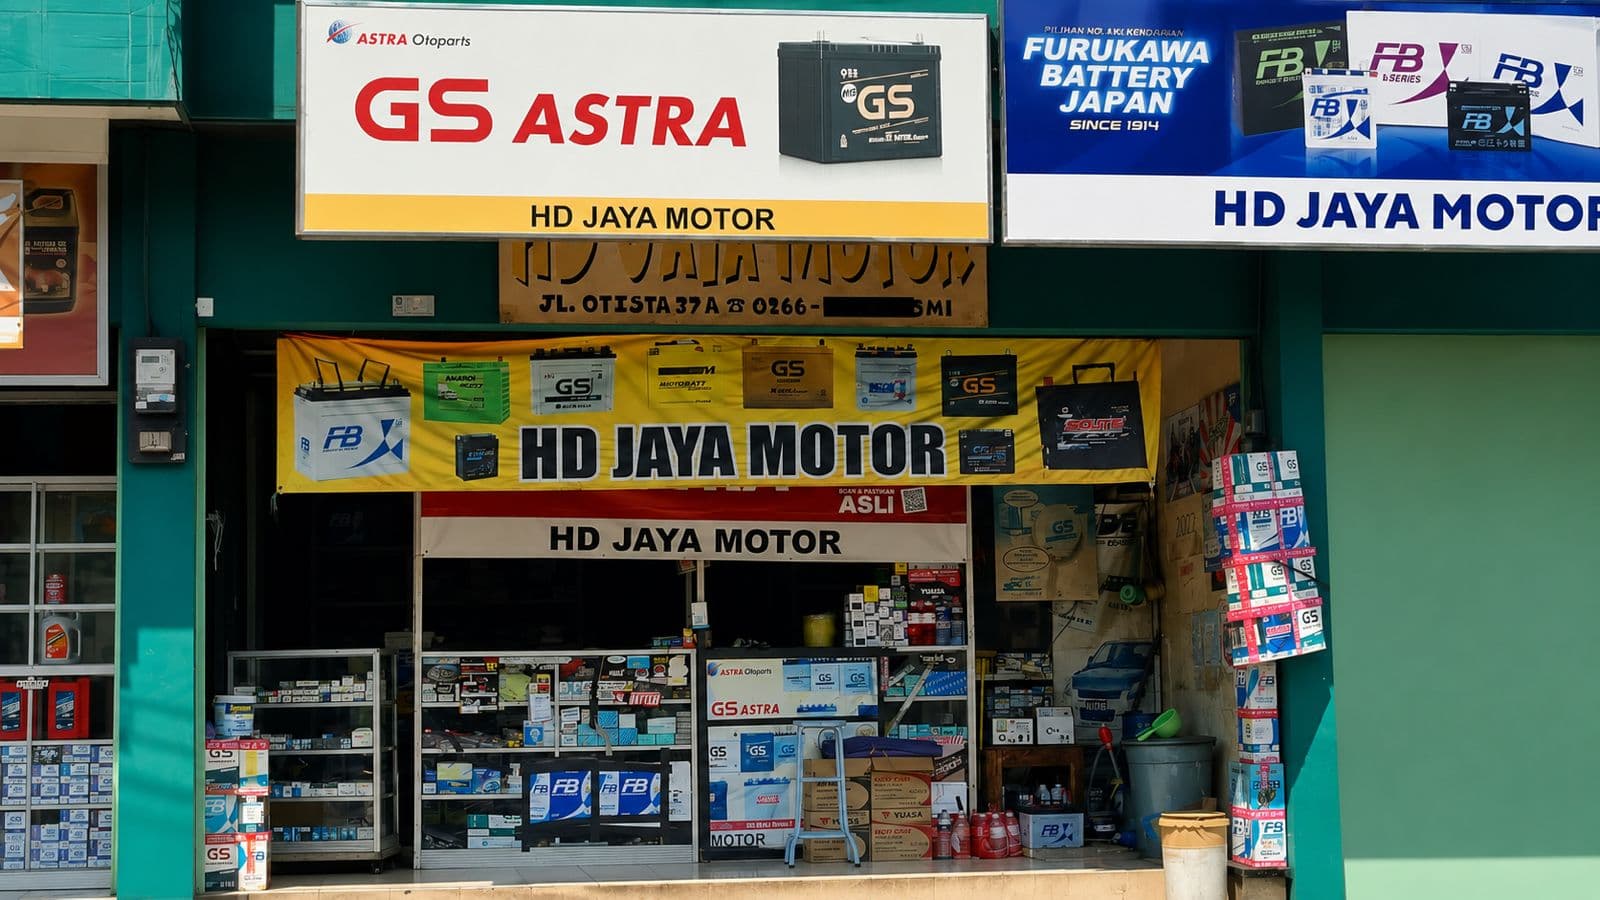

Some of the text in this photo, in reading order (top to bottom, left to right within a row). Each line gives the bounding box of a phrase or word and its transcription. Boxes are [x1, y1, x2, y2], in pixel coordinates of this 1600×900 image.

[357, 32, 471, 49] ASTRA Otoparts
[1023, 37, 1210, 64] FURUKAWA
[1369, 42, 1425, 73] FB
[1255, 47, 1305, 80] FB
[1493, 53, 1545, 88] FB
[1040, 64, 1195, 89] BATTERY
[856, 84, 915, 120] GS
[1059, 90, 1173, 114] JAPAN
[1310, 98, 1341, 117] FB
[355, 77, 747, 148] GS ASTRA
[1462, 112, 1493, 130] FB
[1069, 120, 1159, 131] SINCE 1914
[530, 205, 775, 231] HD JAYA MOTOR
[1214, 190, 1286, 227] HD
[1296, 192, 1419, 229] JAYA
[539, 294, 576, 313] JL.
[582, 295, 671, 314] OTISTA
[771, 360, 805, 377] GS
[555, 377, 591, 395] GS
[962, 377, 996, 394] GS
[322, 425, 364, 450] FB
[519, 423, 948, 482] HD JAYA MOTOR
[1256, 461, 1268, 472] GS
[1286, 459, 1297, 470] GS
[838, 495, 894, 514] ASLI
[1052, 520, 1075, 534] GS
[549, 525, 842, 555] HD JAYA MOTOR
[1300, 559, 1312, 571] GS
[1302, 609, 1319, 624] GS
[720, 668, 772, 677] ASTRA Otoparts
[818, 673, 832, 682] GS
[850, 673, 865, 683] GS
[711, 701, 780, 716] GS ASTRA
[710, 746, 727, 757] GS
[750, 745, 767, 756] GS
[781, 744, 795, 754] GS
[552, 778, 579, 794] FB
[621, 778, 648, 793] FB
[894, 811, 923, 819] YUASA
[1041, 824, 1059, 836] FB
[711, 833, 766, 847] MOTOR
[207, 848, 231, 860] GS
